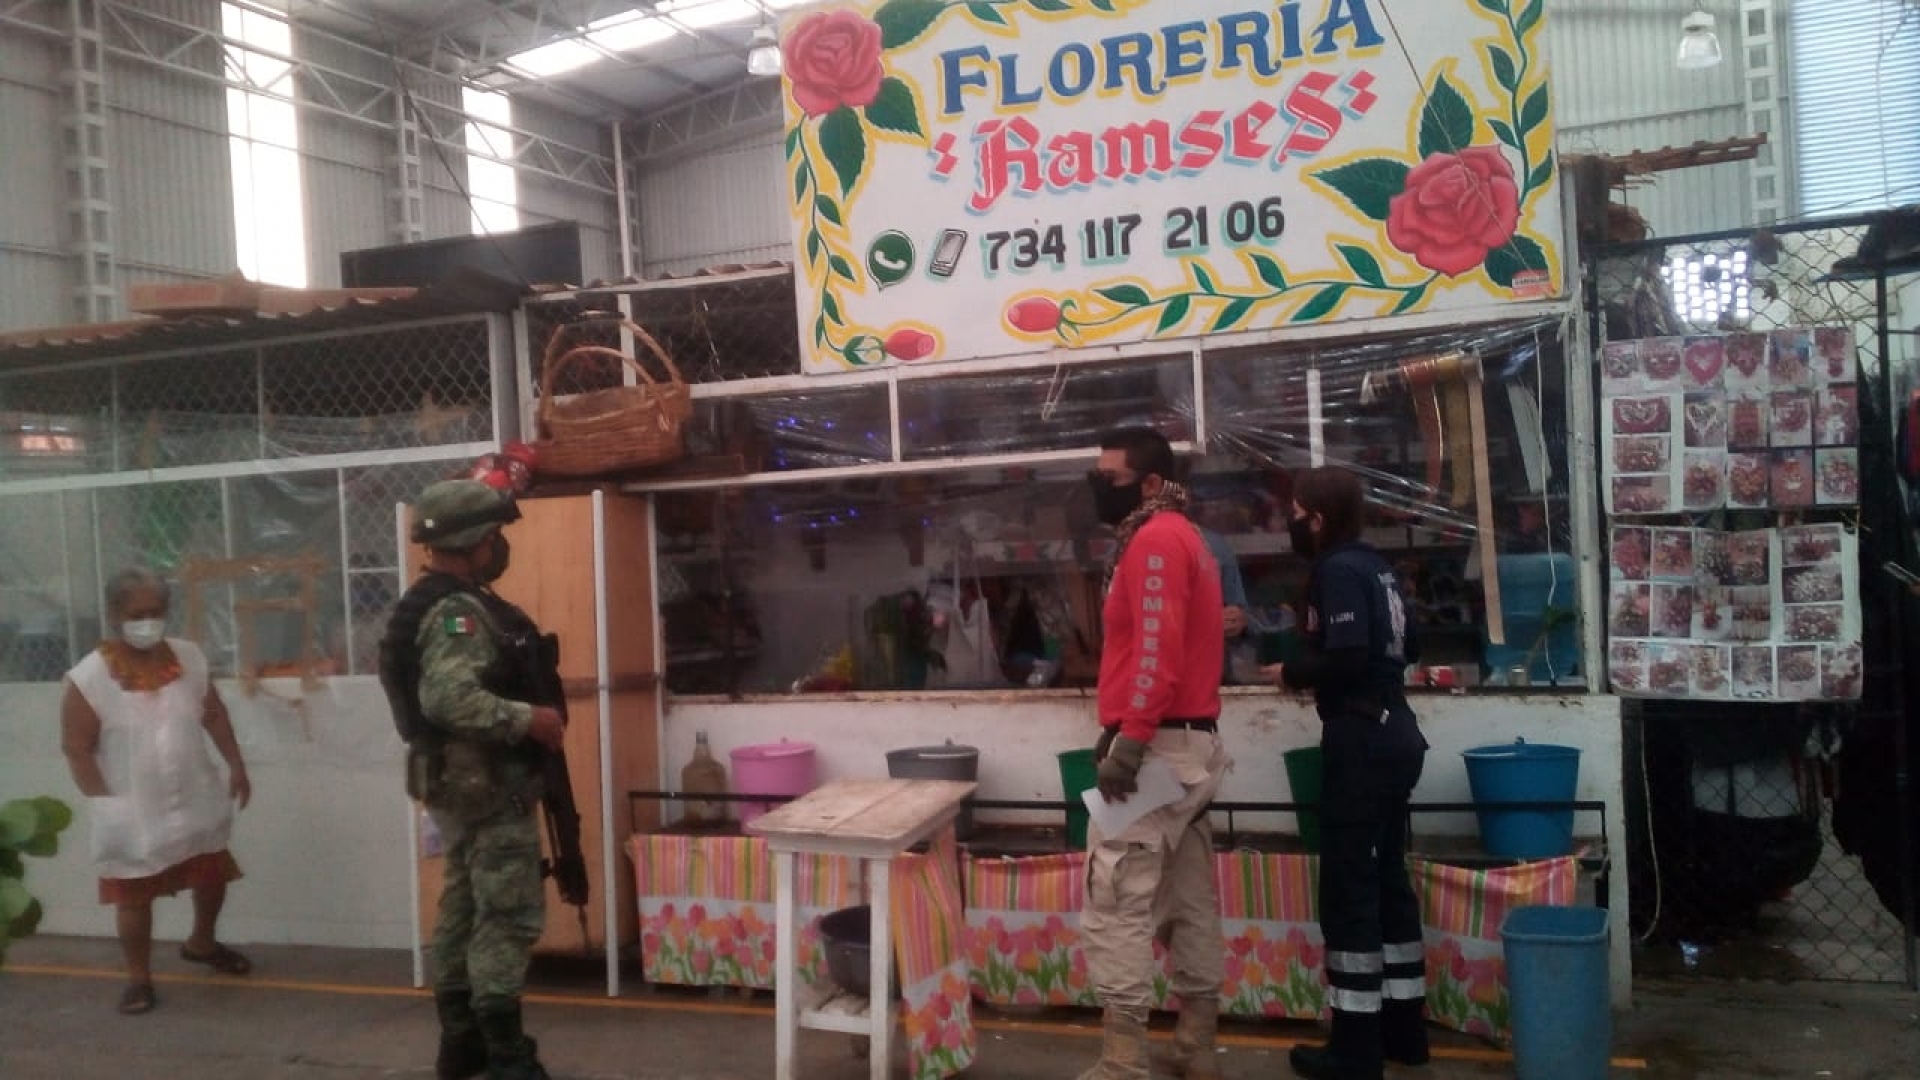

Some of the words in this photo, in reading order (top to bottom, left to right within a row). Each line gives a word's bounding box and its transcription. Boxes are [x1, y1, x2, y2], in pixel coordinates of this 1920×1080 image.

[984, 224, 1067, 271] 734
[1084, 213, 1143, 260] 117
[1166, 206, 1210, 250] 21
[1226, 197, 1286, 243] 06
[1131, 554, 1165, 709] BOMBEROS
